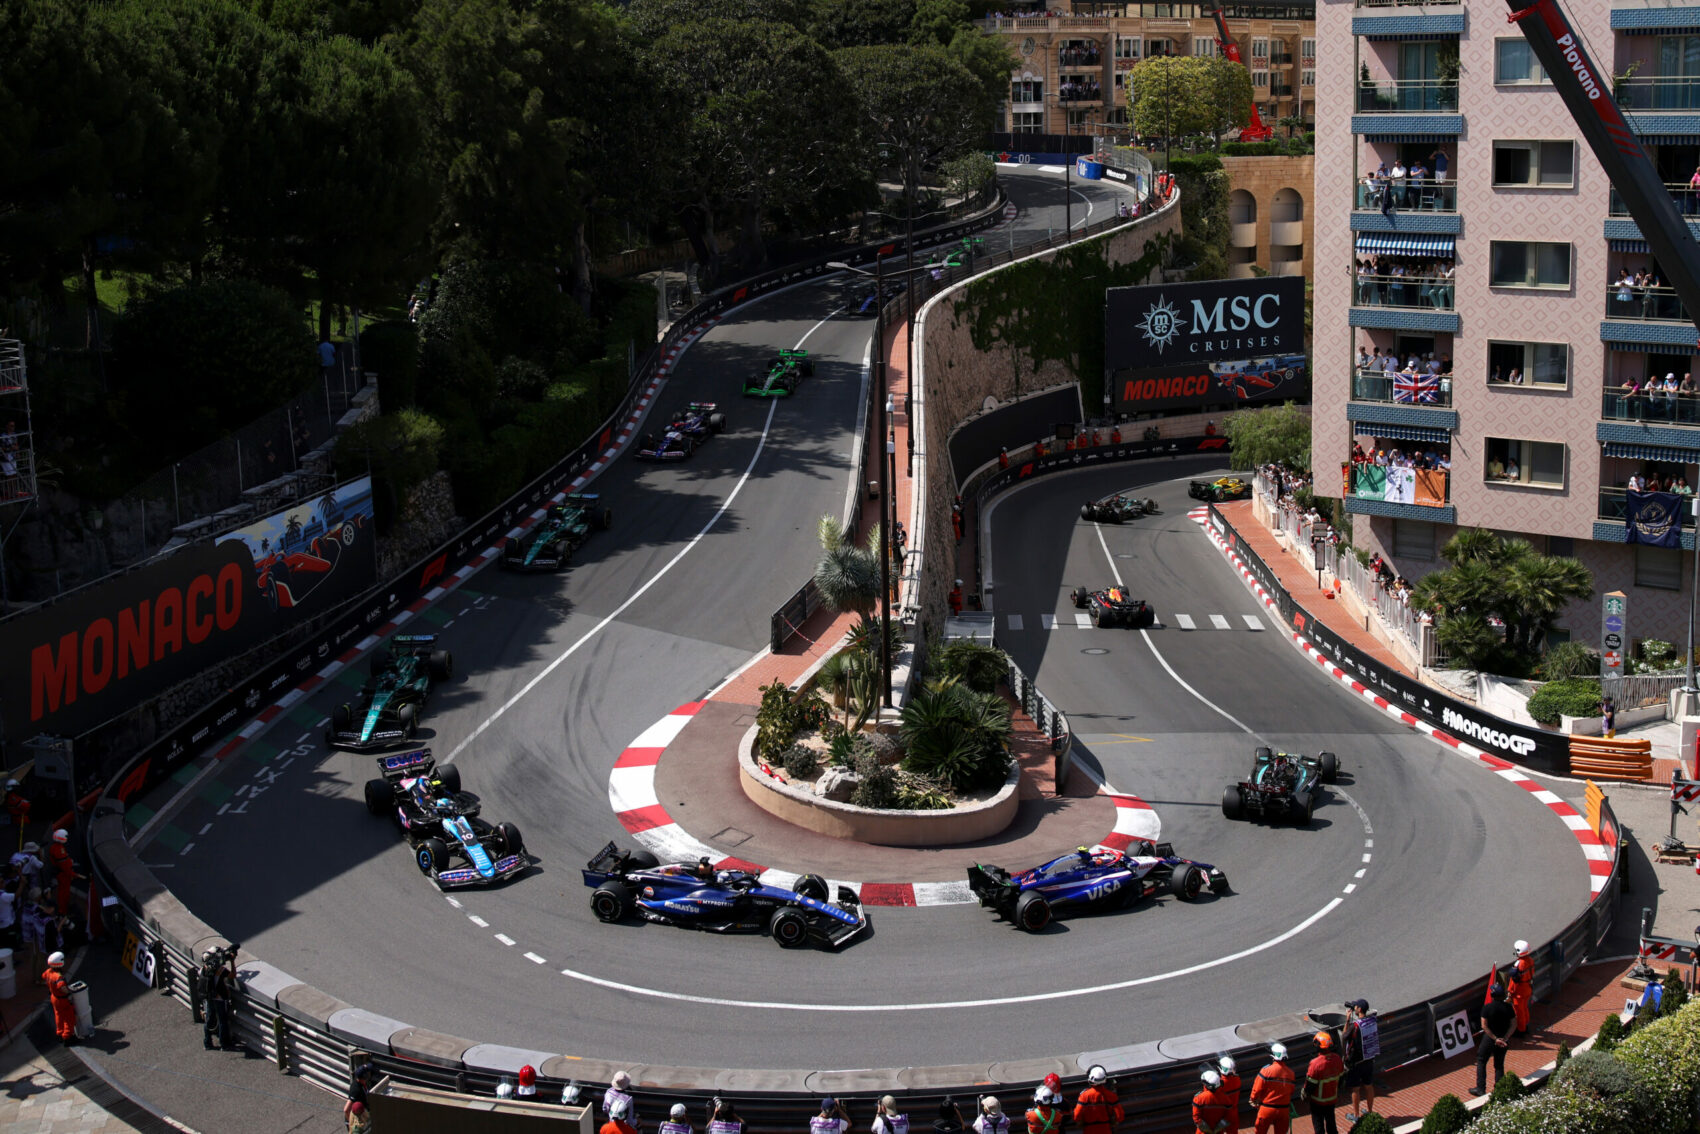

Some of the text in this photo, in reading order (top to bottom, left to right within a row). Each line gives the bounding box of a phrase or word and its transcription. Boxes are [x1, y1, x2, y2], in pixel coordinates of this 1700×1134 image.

[1557, 33, 1600, 100] Piovano
[1190, 294, 1280, 334] MSC
[1190, 336, 1280, 353] CRUISES
[1123, 375, 1209, 401] MONACO
[30, 562, 243, 723] MONACO
[1442, 706, 1536, 756] #MonacoGP
[228, 744, 317, 814] TAXIS
[1247, 783, 1281, 793] INEOS
[461, 832, 474, 841] 10
[1085, 879, 1122, 901] VISA
[664, 900, 700, 913] KOMATSU
[136, 948, 153, 980] SC
[1441, 1017, 1470, 1051] SC
